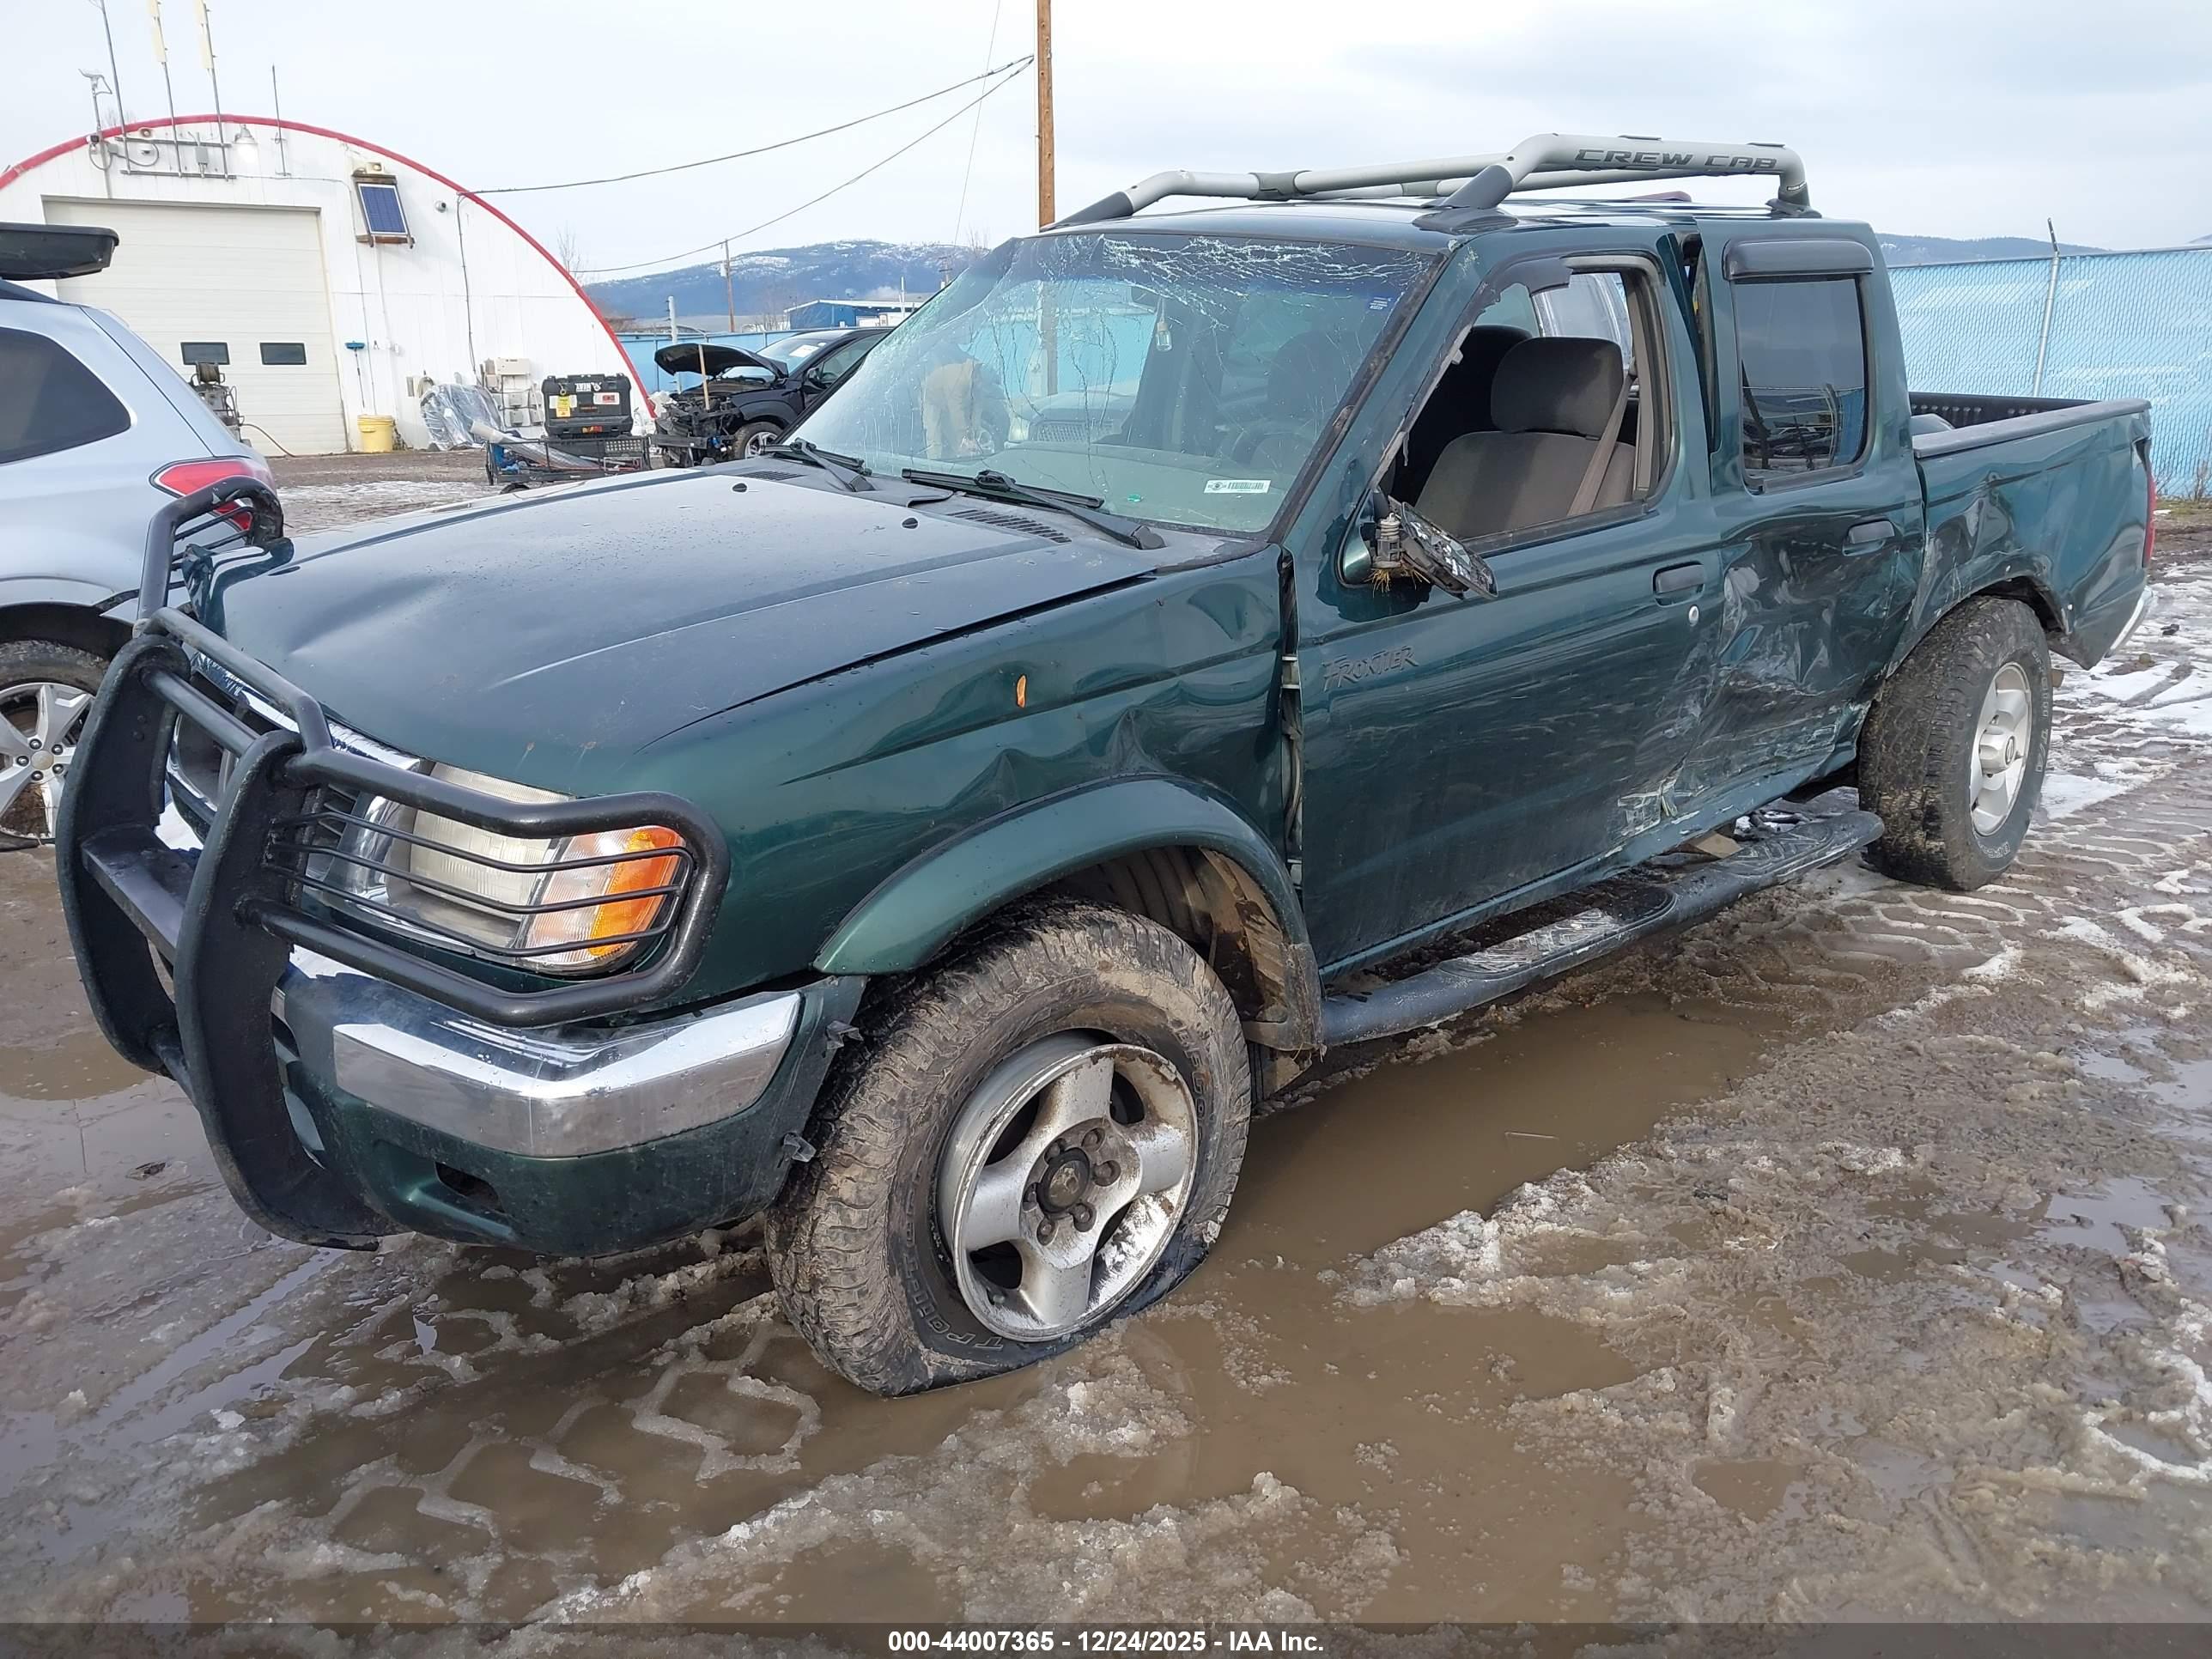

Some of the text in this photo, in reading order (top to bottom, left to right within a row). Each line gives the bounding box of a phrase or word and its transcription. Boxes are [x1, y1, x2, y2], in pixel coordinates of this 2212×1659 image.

[1575, 149, 1777, 168] CREW CAB
[1322, 645, 1419, 692] FRONTIER
